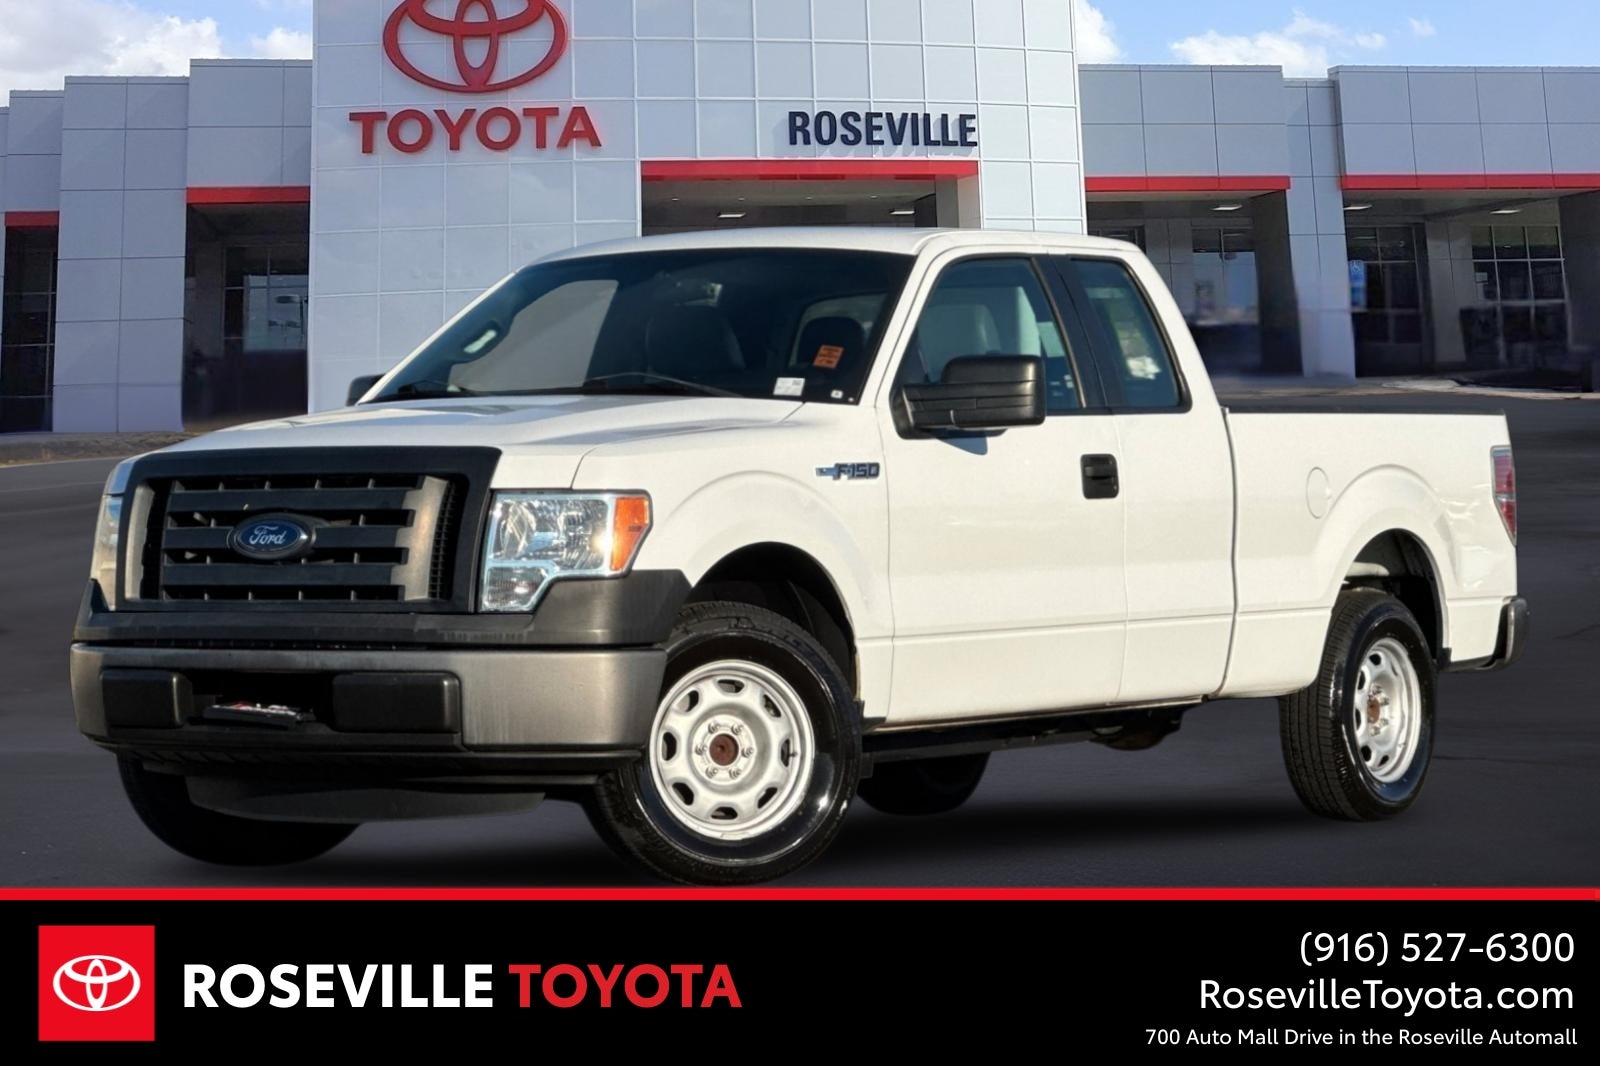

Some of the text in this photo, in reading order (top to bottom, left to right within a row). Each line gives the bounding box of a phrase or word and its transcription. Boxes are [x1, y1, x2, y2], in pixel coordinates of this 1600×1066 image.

[349, 106, 602, 154] TOYOTA
[788, 110, 978, 147] ROSEVILLE
[249, 525, 287, 545] Ford
